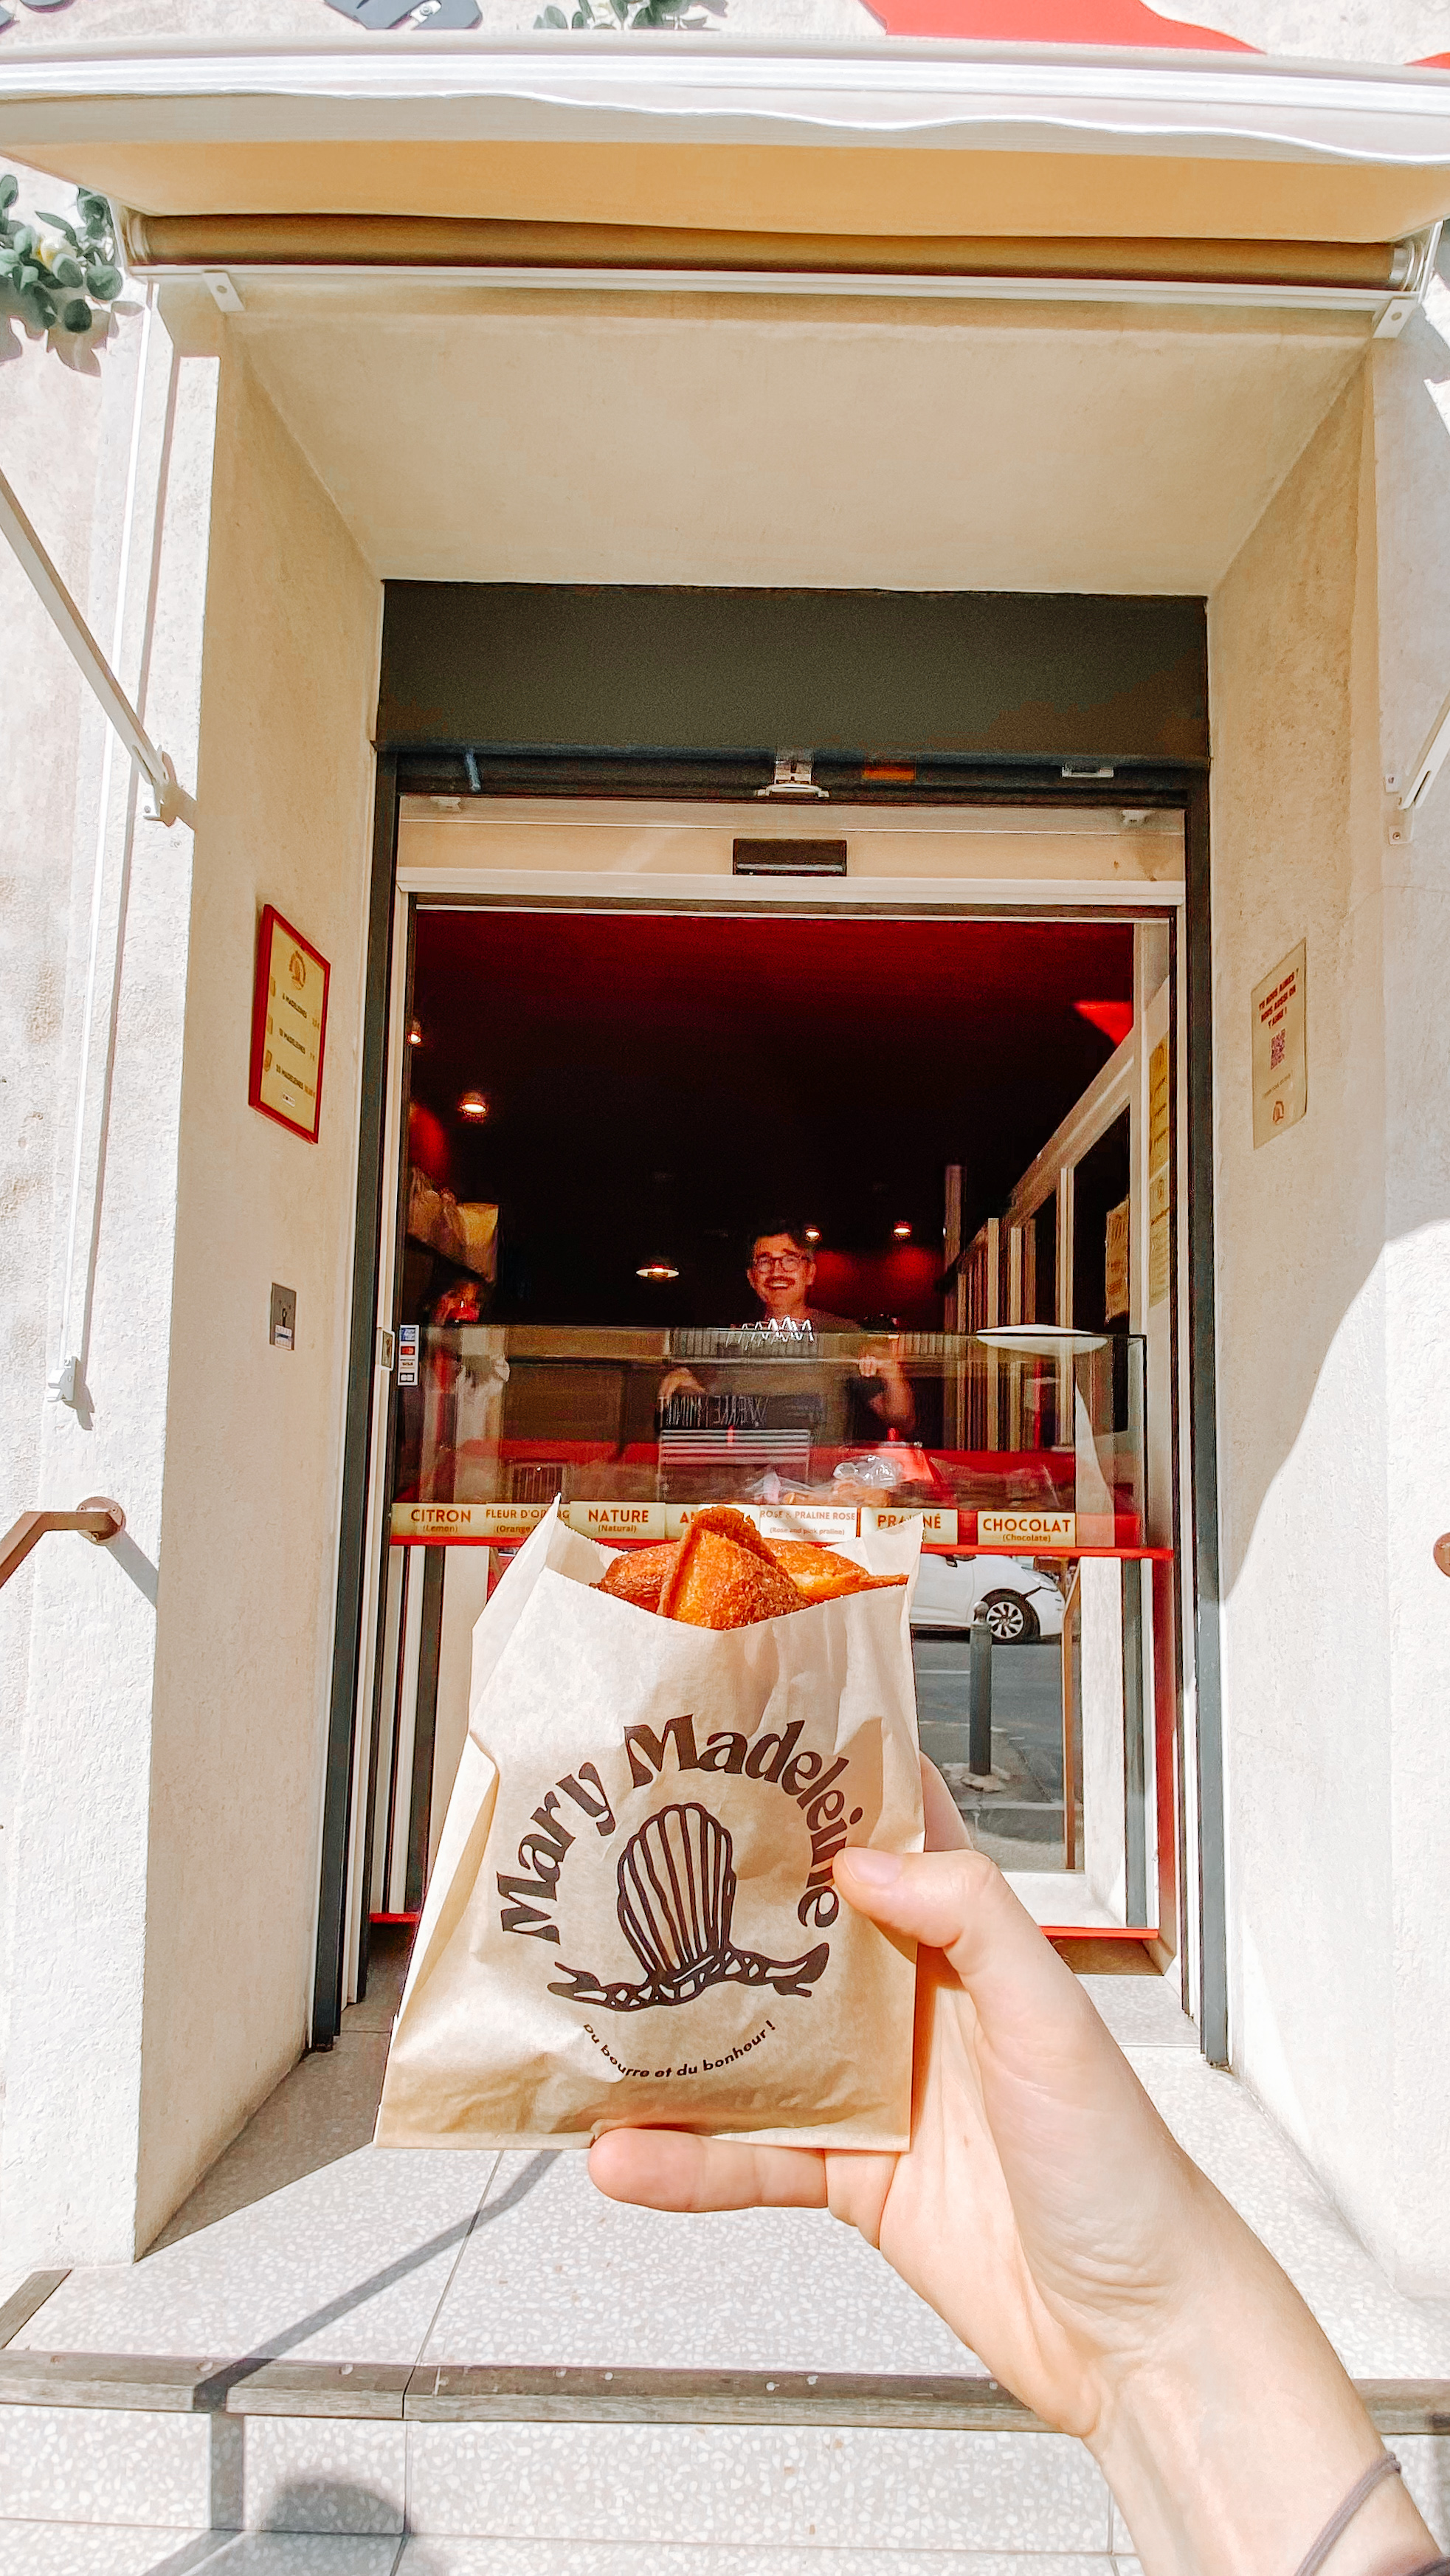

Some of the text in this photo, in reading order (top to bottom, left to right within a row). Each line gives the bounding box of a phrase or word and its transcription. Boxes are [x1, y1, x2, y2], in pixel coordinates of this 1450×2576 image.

[411, 1509, 472, 1523] CITRON
[486, 1509, 517, 1518] FLEUR
[588, 1509, 649, 1523] NATURE
[795, 1511, 830, 1520] PRALINE
[832, 1512, 855, 1521] ROSE
[877, 1513, 941, 1529] PRNÉ
[983, 1518, 1071, 1532] CHOCOLAT
[598, 1525, 637, 1533] (Natural)
[1002, 1534, 1051, 1542] (Chocolate)
[497, 1713, 863, 1946] Mary Madeleine
[676, 2063, 698, 2076] du
